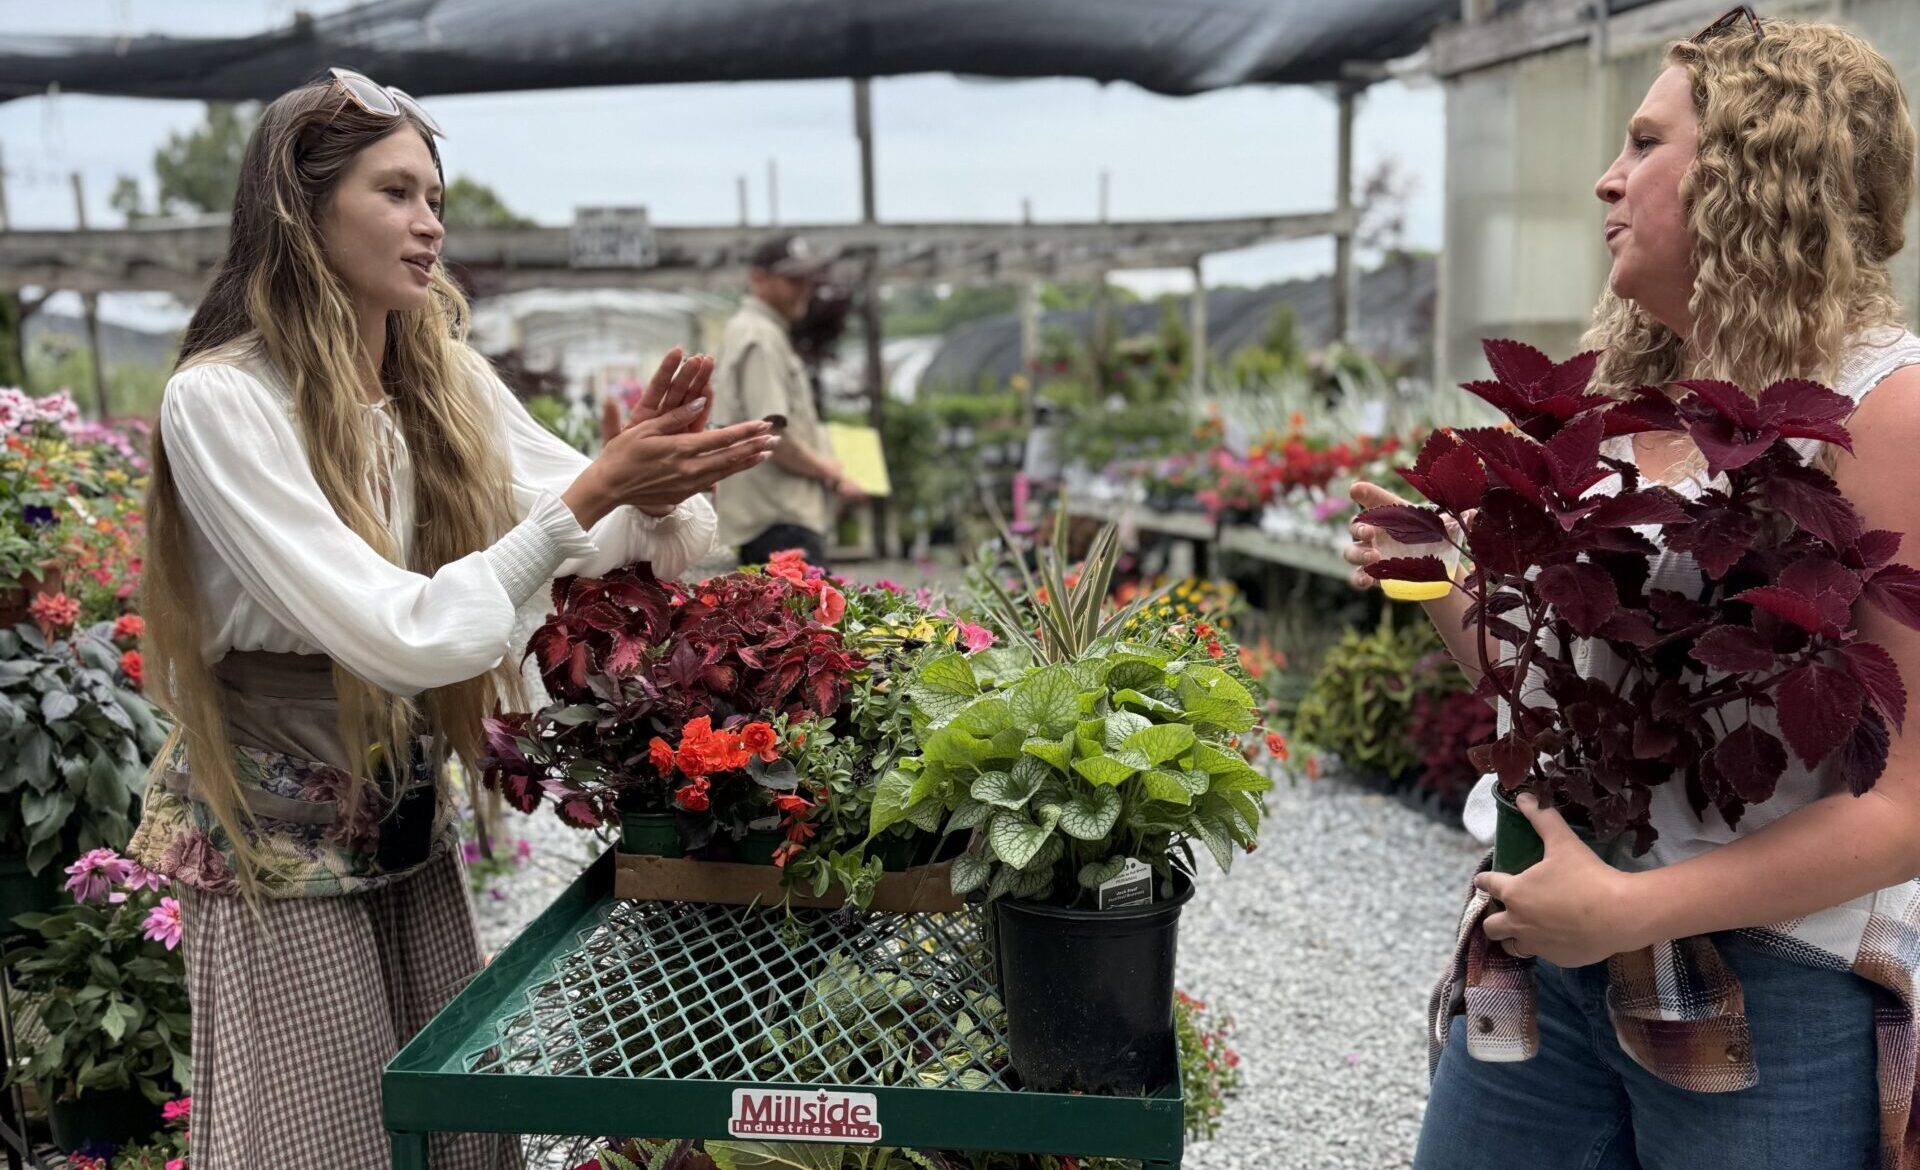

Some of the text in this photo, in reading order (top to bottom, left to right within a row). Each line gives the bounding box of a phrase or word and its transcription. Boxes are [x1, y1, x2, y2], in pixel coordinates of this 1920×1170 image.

[740, 1093, 871, 1125] Millside
[735, 1121, 877, 1136] Industries Inc.
